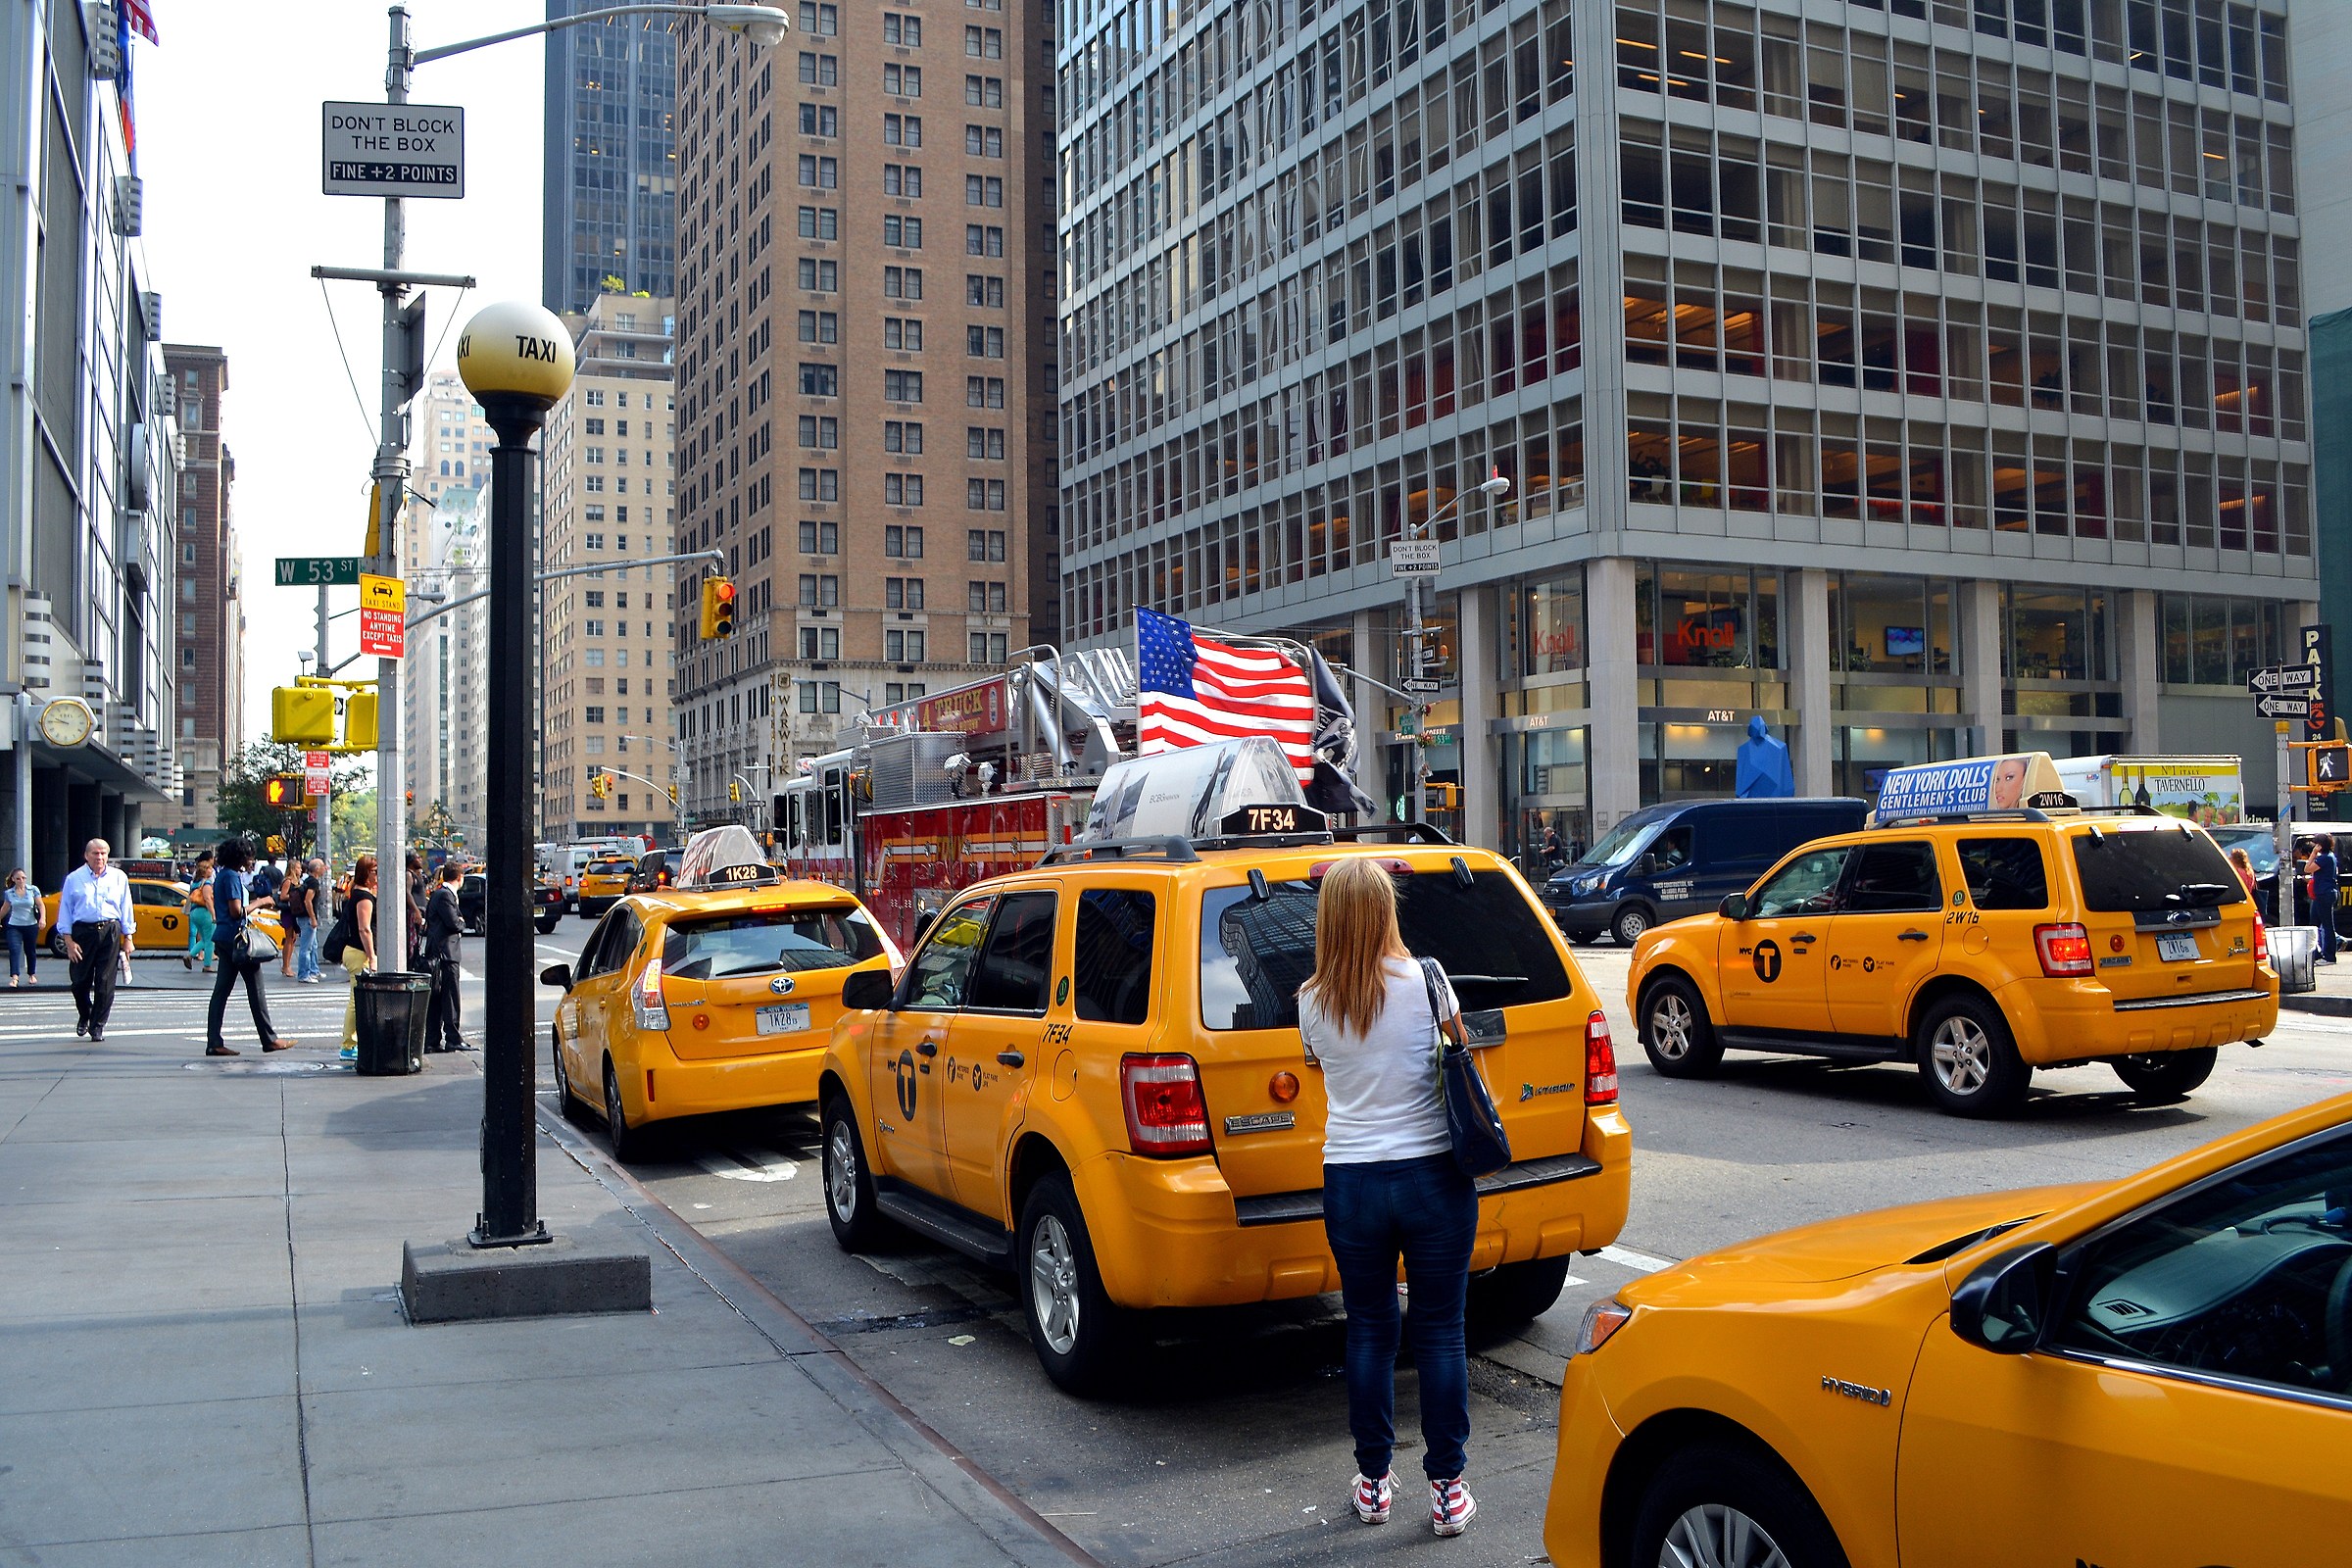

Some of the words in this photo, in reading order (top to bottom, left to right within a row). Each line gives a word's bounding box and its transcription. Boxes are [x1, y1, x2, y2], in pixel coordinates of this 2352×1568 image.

[331, 116, 386, 131] DON'T
[393, 118, 455, 133] BLOCK
[351, 135, 390, 151] THE
[398, 137, 435, 153] BOX
[333, 164, 367, 178] FINE
[371, 165, 394, 180] +2
[402, 166, 455, 182] POINTS
[458, 335, 470, 359] XI
[515, 335, 557, 364] TAXI
[279, 561, 295, 582] W
[309, 561, 334, 582] 53
[341, 561, 353, 571] ST
[366, 598, 379, 607] TAXI
[382, 600, 400, 610] STAND
[364, 611, 371, 619] NO
[373, 612, 402, 623] STANDING
[369, 621, 396, 633] ANYTIME
[1678, 619, 1735, 649] Knoll
[363, 630, 384, 642] EXCEPT
[387, 634, 402, 644] TAXIS
[1535, 625, 1575, 658] Knoll
[2259, 675, 2278, 685] ONE
[2286, 672, 2306, 683] WAY
[935, 688, 983, 721] TRUCK
[2264, 701, 2279, 711] ONE
[2287, 702, 2303, 712] WAY
[1530, 715, 1548, 727] AT&T
[1707, 710, 1735, 721] AT&T
[778, 696, 790, 774] WARWICK
[1884, 772, 1916, 796] NEW
[1915, 769, 1948, 792] YORK
[1948, 765, 1990, 789] DOLLS
[2155, 778, 2205, 793] TAVERNELLO
[1881, 790, 1954, 809] GENTLEMEN'S
[1958, 788, 1986, 804] CLUB
[2039, 793, 2064, 807] 2W16
[1248, 808, 1295, 831] 7F34
[726, 865, 758, 881] 1K28
[1946, 911, 1980, 924] 2W16
[1759, 948, 1776, 977] T
[1042, 1024, 1073, 1045] 7F34
[887, 1059, 896, 1073] NYC
[901, 1064, 912, 1112] T
[1231, 1115, 1290, 1128] ESCAPE
[1822, 1375, 1882, 1404] HYBRID
